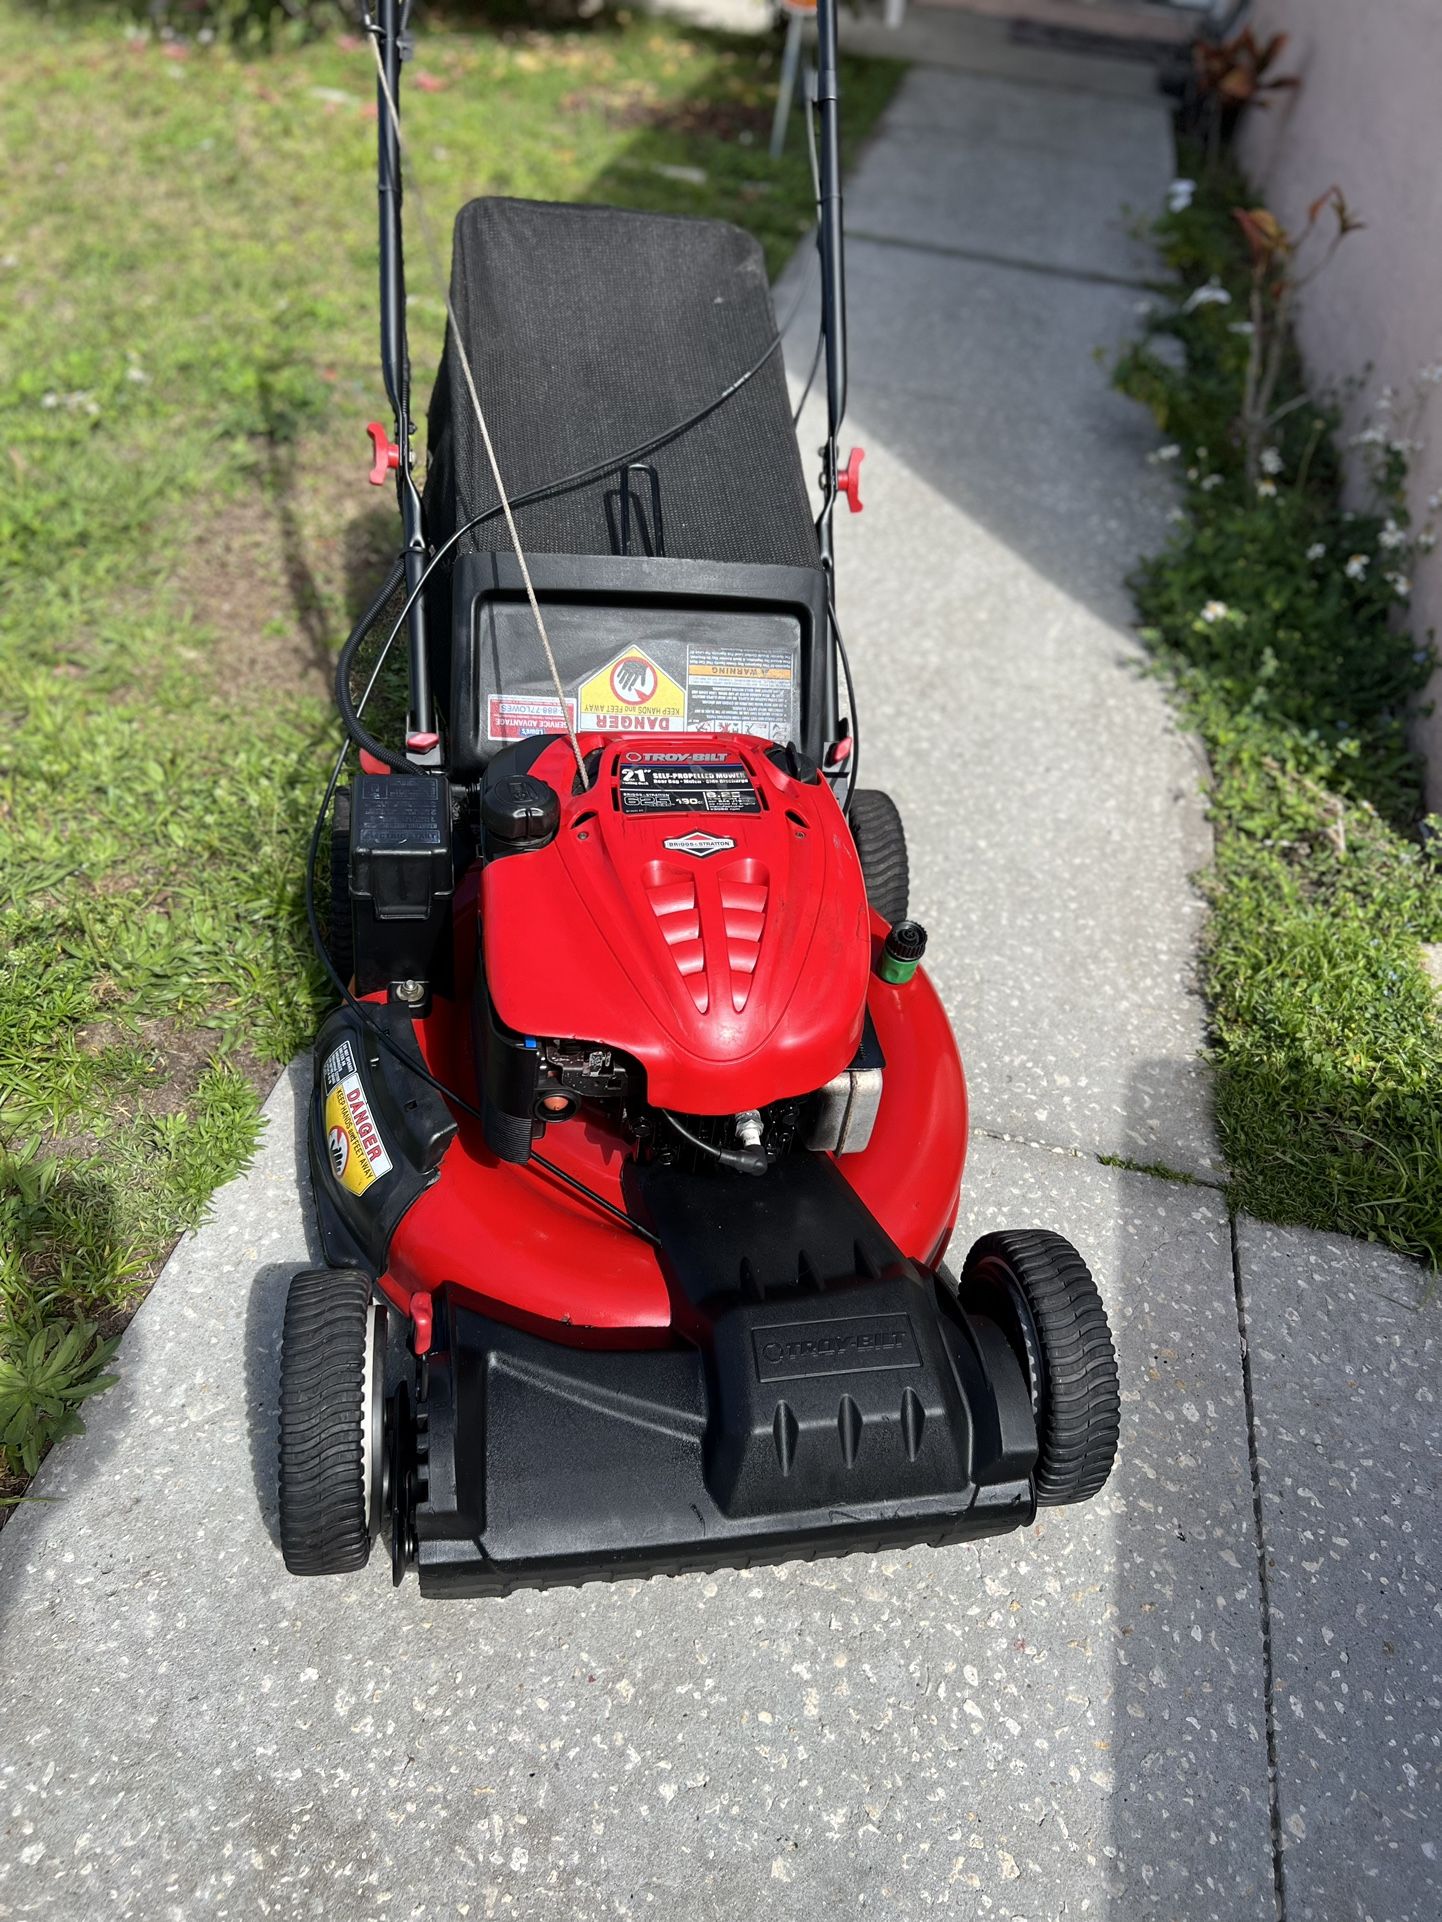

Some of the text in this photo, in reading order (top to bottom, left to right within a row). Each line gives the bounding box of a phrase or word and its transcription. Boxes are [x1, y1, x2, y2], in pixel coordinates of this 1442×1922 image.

[711, 666, 758, 675] WARNING
[584, 704, 605, 712] AWAY
[606, 705, 623, 713] FEET
[638, 706, 660, 714] HANDS
[662, 707, 680, 715] KEEP
[495, 718, 568, 728] SERVICE ADVANTAGE
[596, 715, 670, 731] DANGER
[644, 753, 728, 762] TROY-BILT
[624, 796, 672, 807] 625
[347, 1088, 382, 1162] DANGER
[336, 1088, 374, 1179] KEEP HANDS and FEET AWAY
[785, 1331, 906, 1360] TROY-BILT
